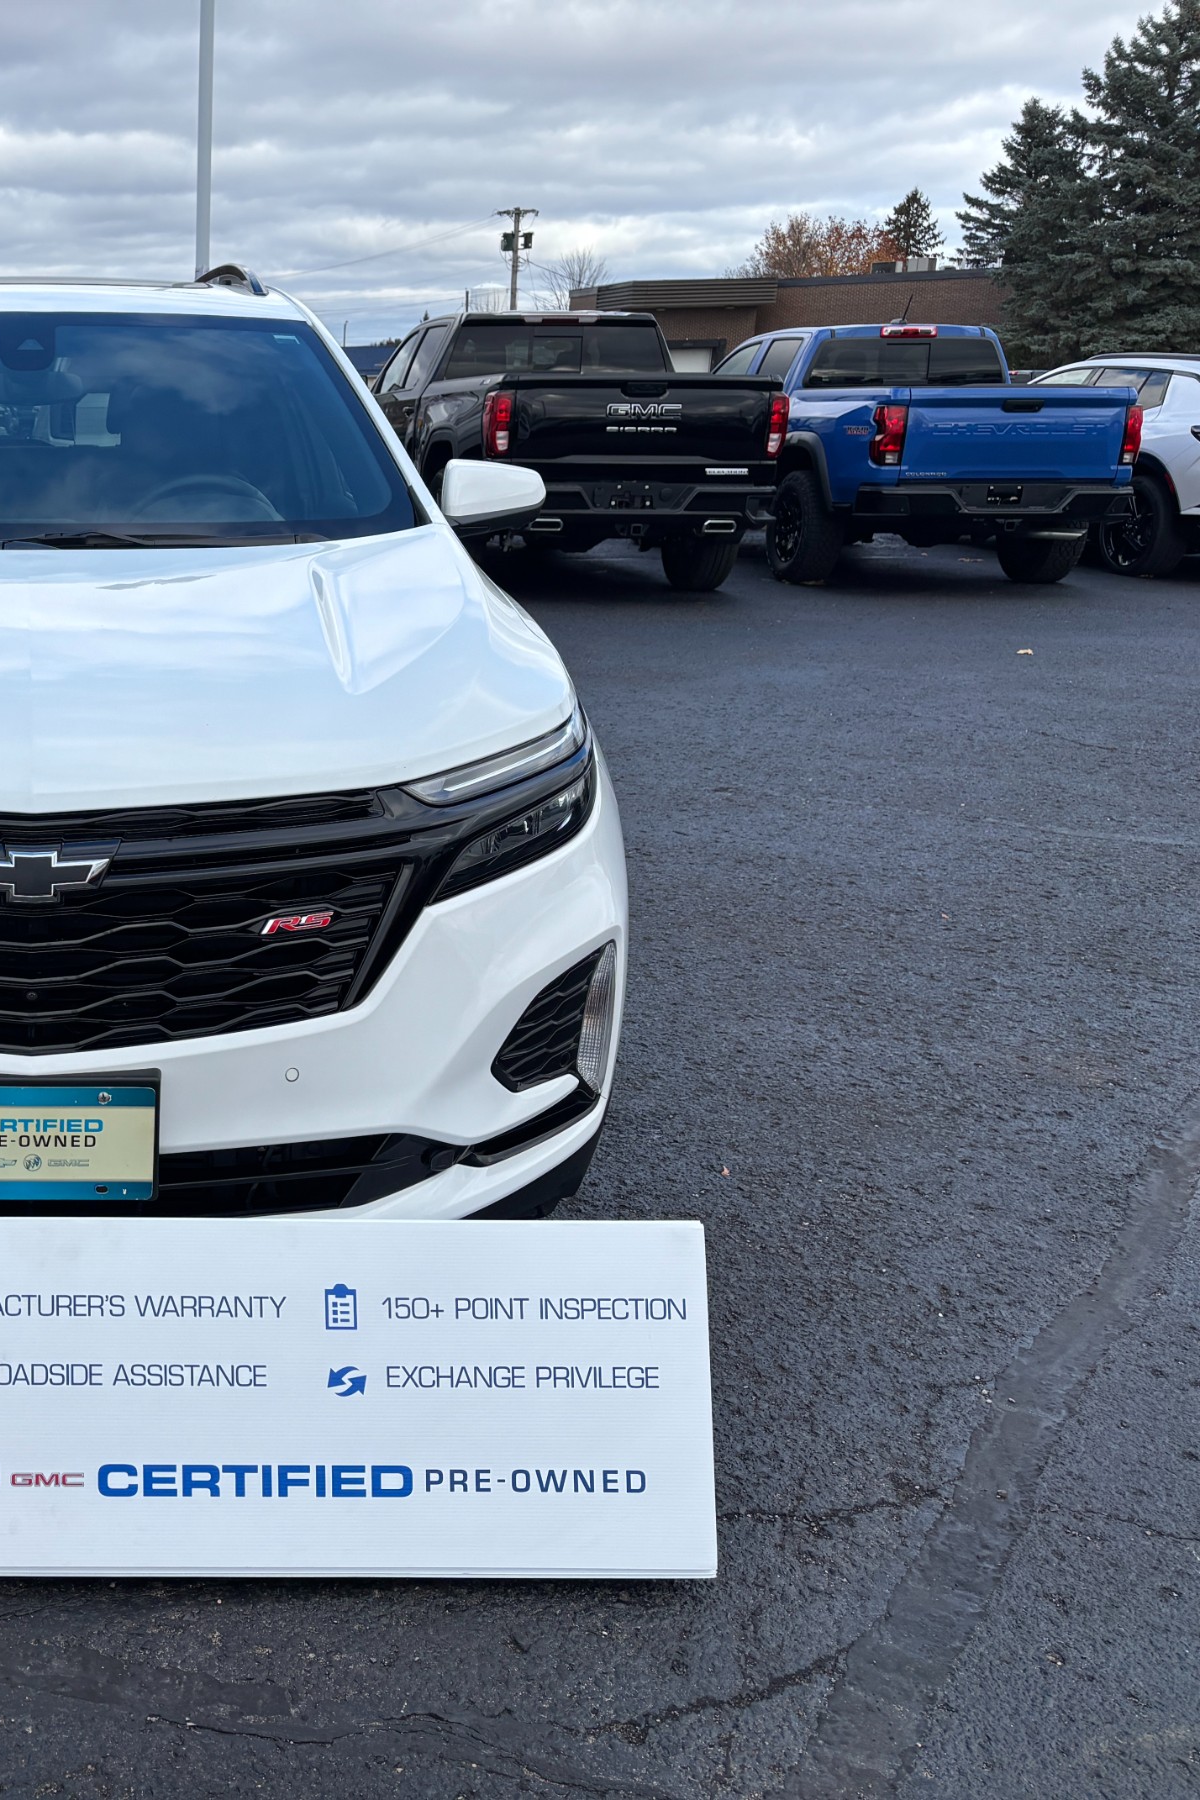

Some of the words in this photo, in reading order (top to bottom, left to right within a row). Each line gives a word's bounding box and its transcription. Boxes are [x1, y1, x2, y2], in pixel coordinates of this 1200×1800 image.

[607, 403, 682, 419] GMC
[261, 911, 334, 934] RS
[135, 1296, 287, 1318] WARRANTY
[381, 1297, 444, 1320] 150+
[455, 1298, 529, 1320] POINT
[539, 1298, 686, 1320] INSPECTION
[112, 1364, 267, 1388] ASSISTANCE
[386, 1366, 526, 1389] EXCHANGE
[536, 1366, 659, 1389] PRIVILEGE
[10, 1472, 85, 1488] GMC
[97, 1464, 413, 1498] CERTIFIED
[425, 1469, 647, 1493] PRE-OWNED
